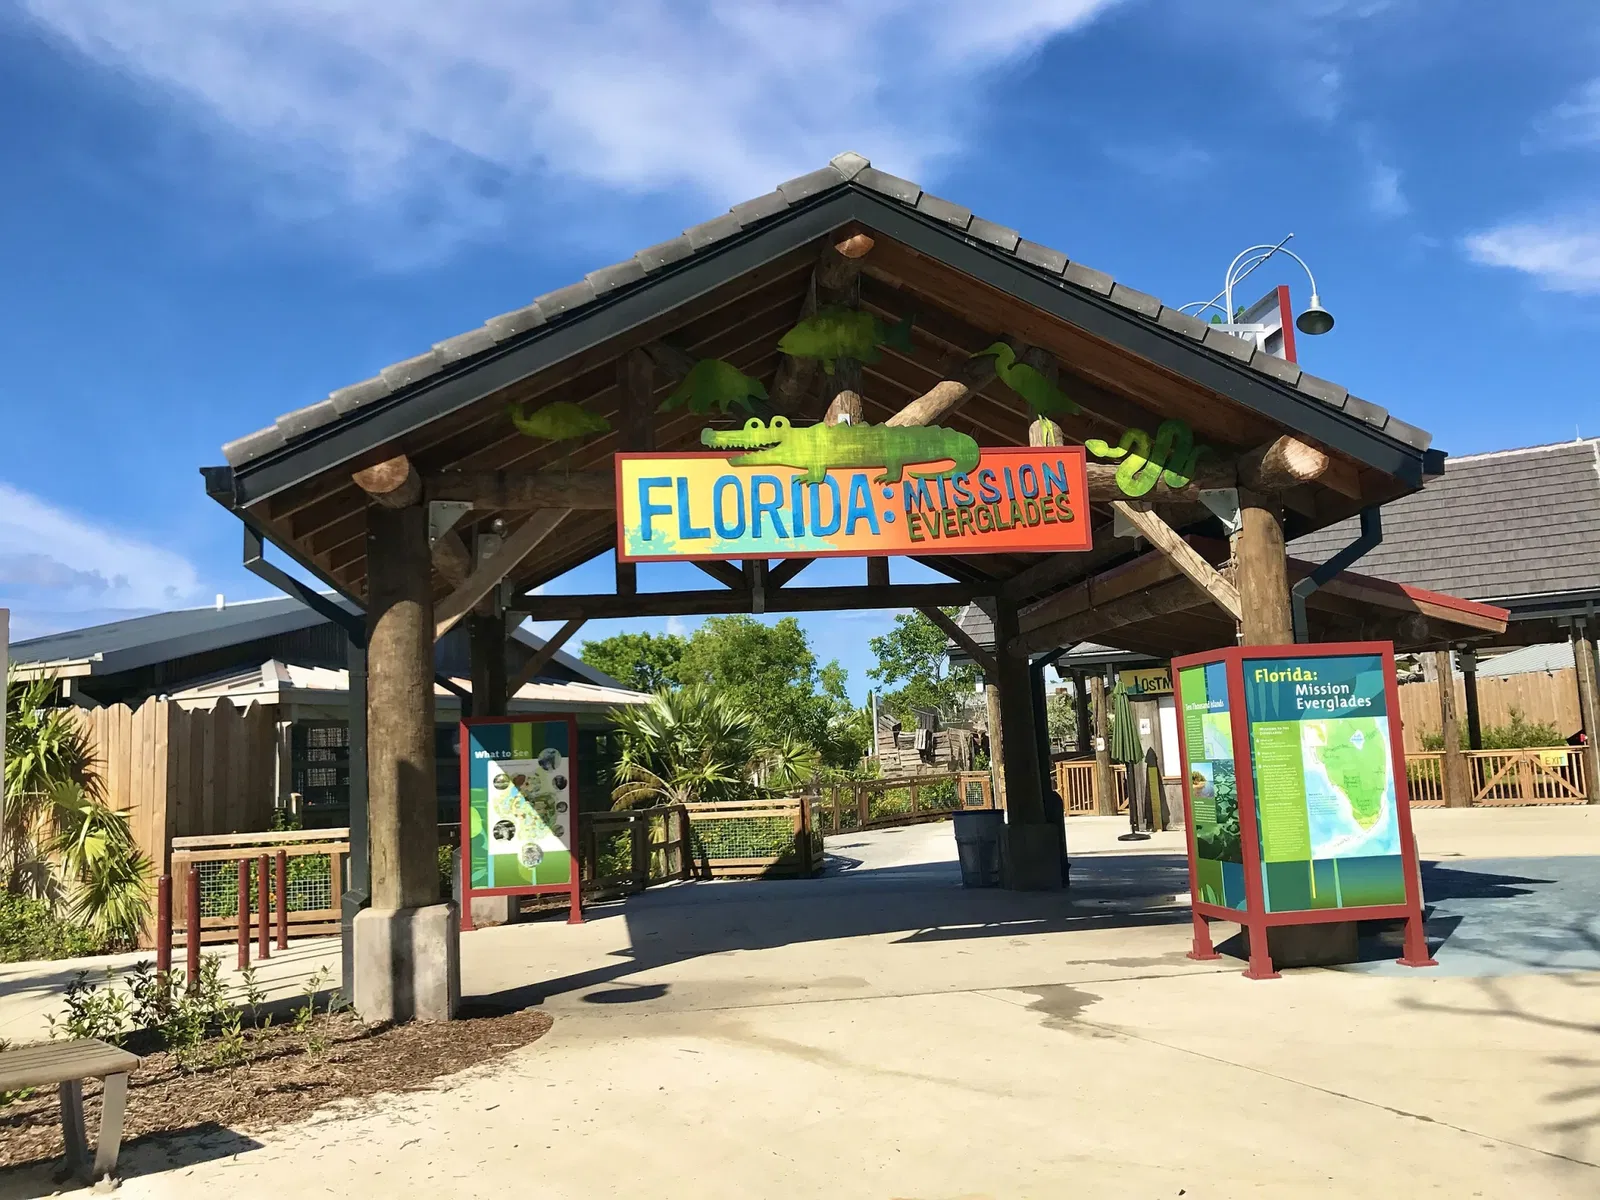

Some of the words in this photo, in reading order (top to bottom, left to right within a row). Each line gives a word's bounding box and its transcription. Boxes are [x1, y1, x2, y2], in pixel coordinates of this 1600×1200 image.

[902, 460, 1070, 514] MISSION
[638, 474, 895, 541] FLORIDA:
[906, 493, 1075, 543] EVERGLADES
[1255, 667, 1318, 683] Florida:
[1295, 682, 1350, 696] Mission
[1296, 694, 1372, 712] Everglades
[474, 750, 500, 759] What
[502, 750, 512, 758] to
[513, 749, 529, 757] See
[1545, 756, 1565, 765] EXIT
